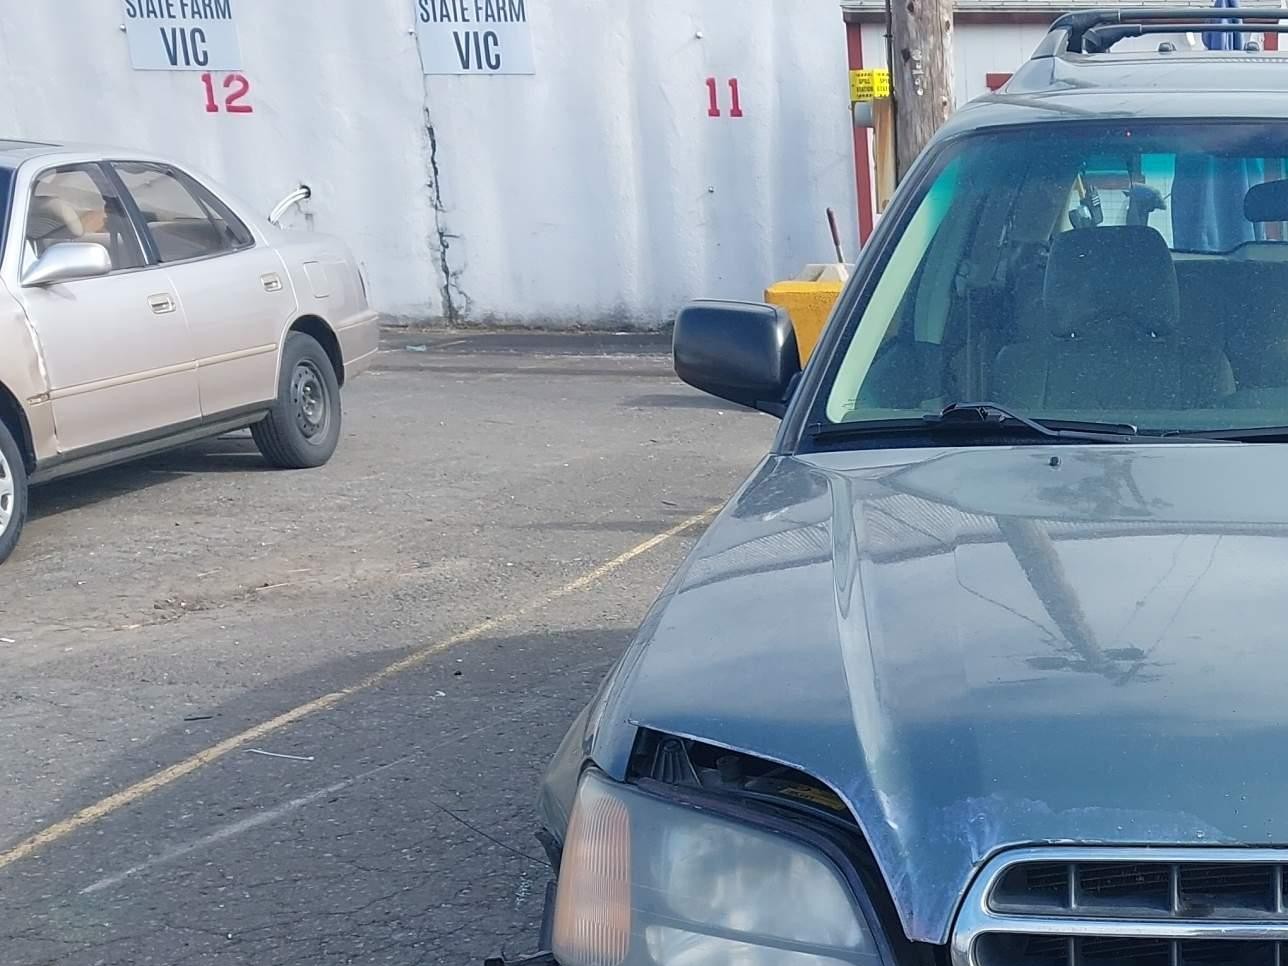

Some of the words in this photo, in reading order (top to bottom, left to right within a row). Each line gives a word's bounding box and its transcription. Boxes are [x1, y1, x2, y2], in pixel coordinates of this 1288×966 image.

[125, 0, 177, 19] STATE
[180, 0, 232, 20] FARM
[419, 0, 470, 23] STATE
[474, 0, 526, 23] FARM
[159, 27, 209, 67] VIC
[452, 30, 502, 71] VIC
[201, 73, 253, 113] 12
[705, 77, 743, 118] 11
